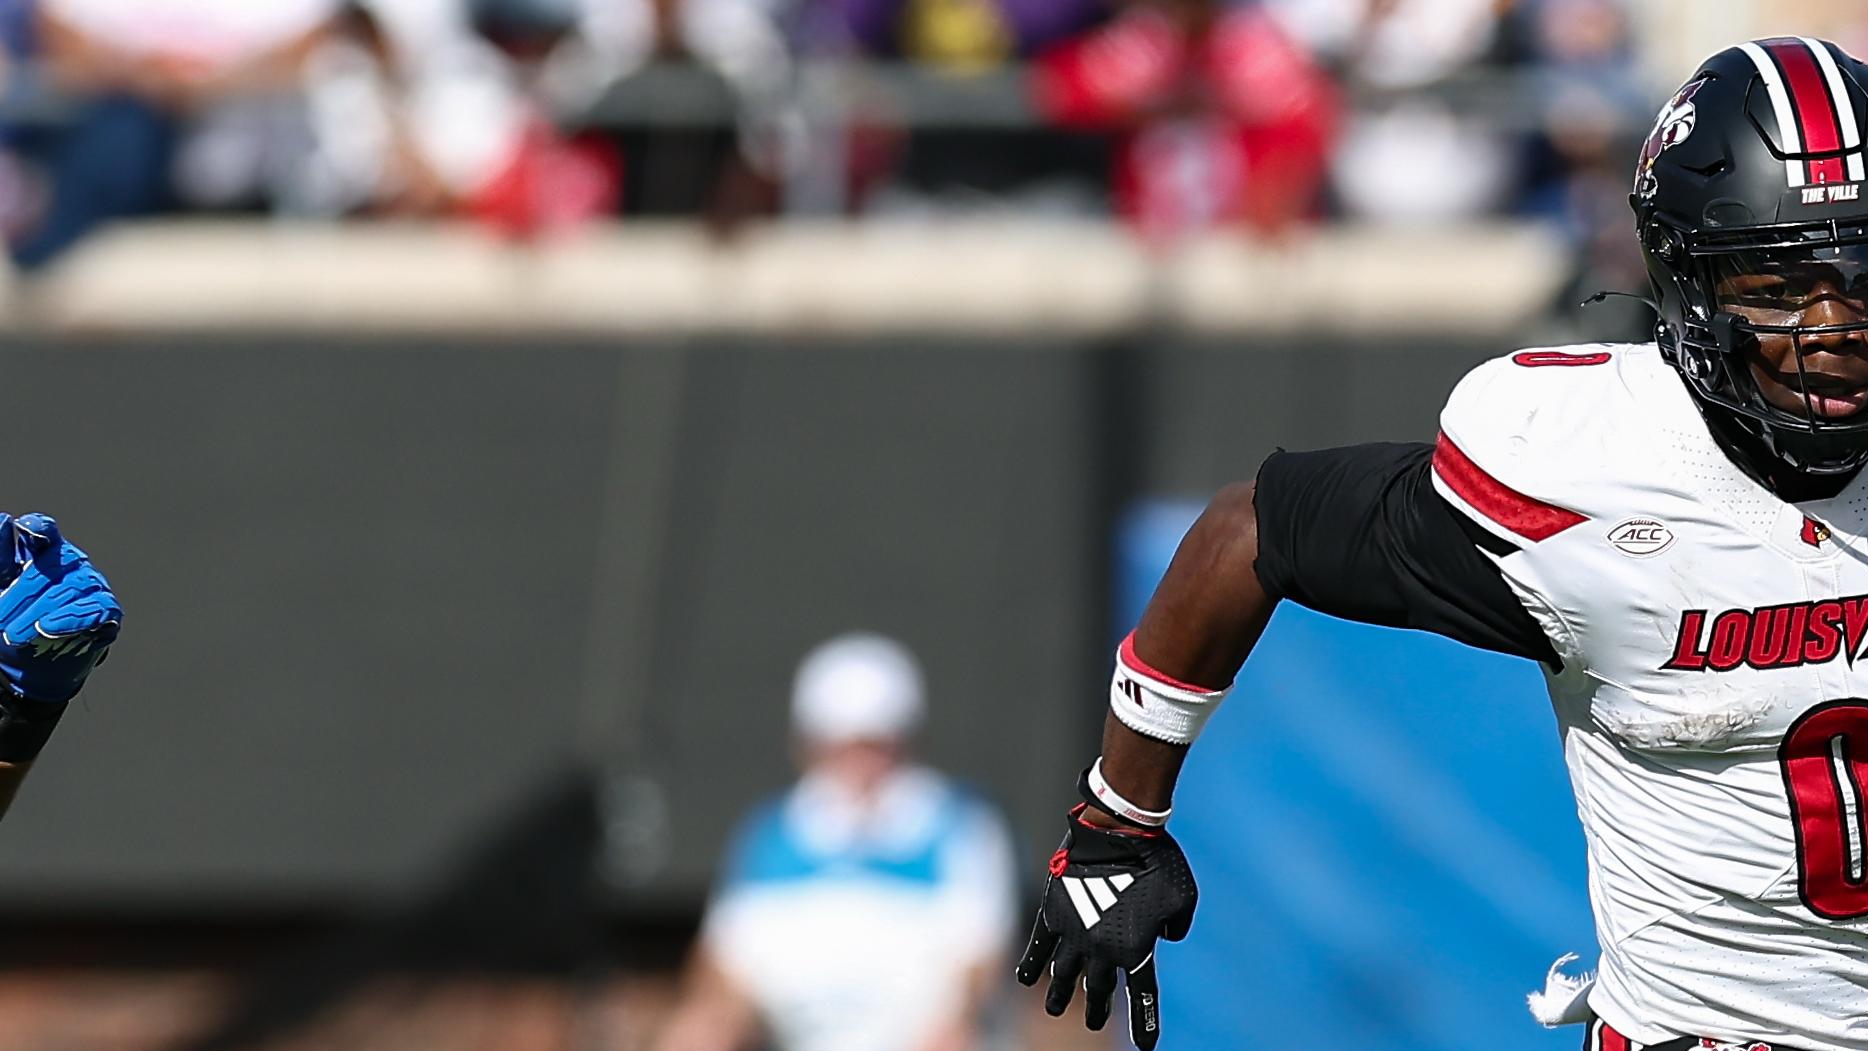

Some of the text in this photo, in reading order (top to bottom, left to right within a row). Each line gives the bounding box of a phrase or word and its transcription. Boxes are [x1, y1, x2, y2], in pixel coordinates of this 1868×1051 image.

[1801, 184, 1859, 204] THE VILLE
[1617, 528, 1665, 541] ACC
